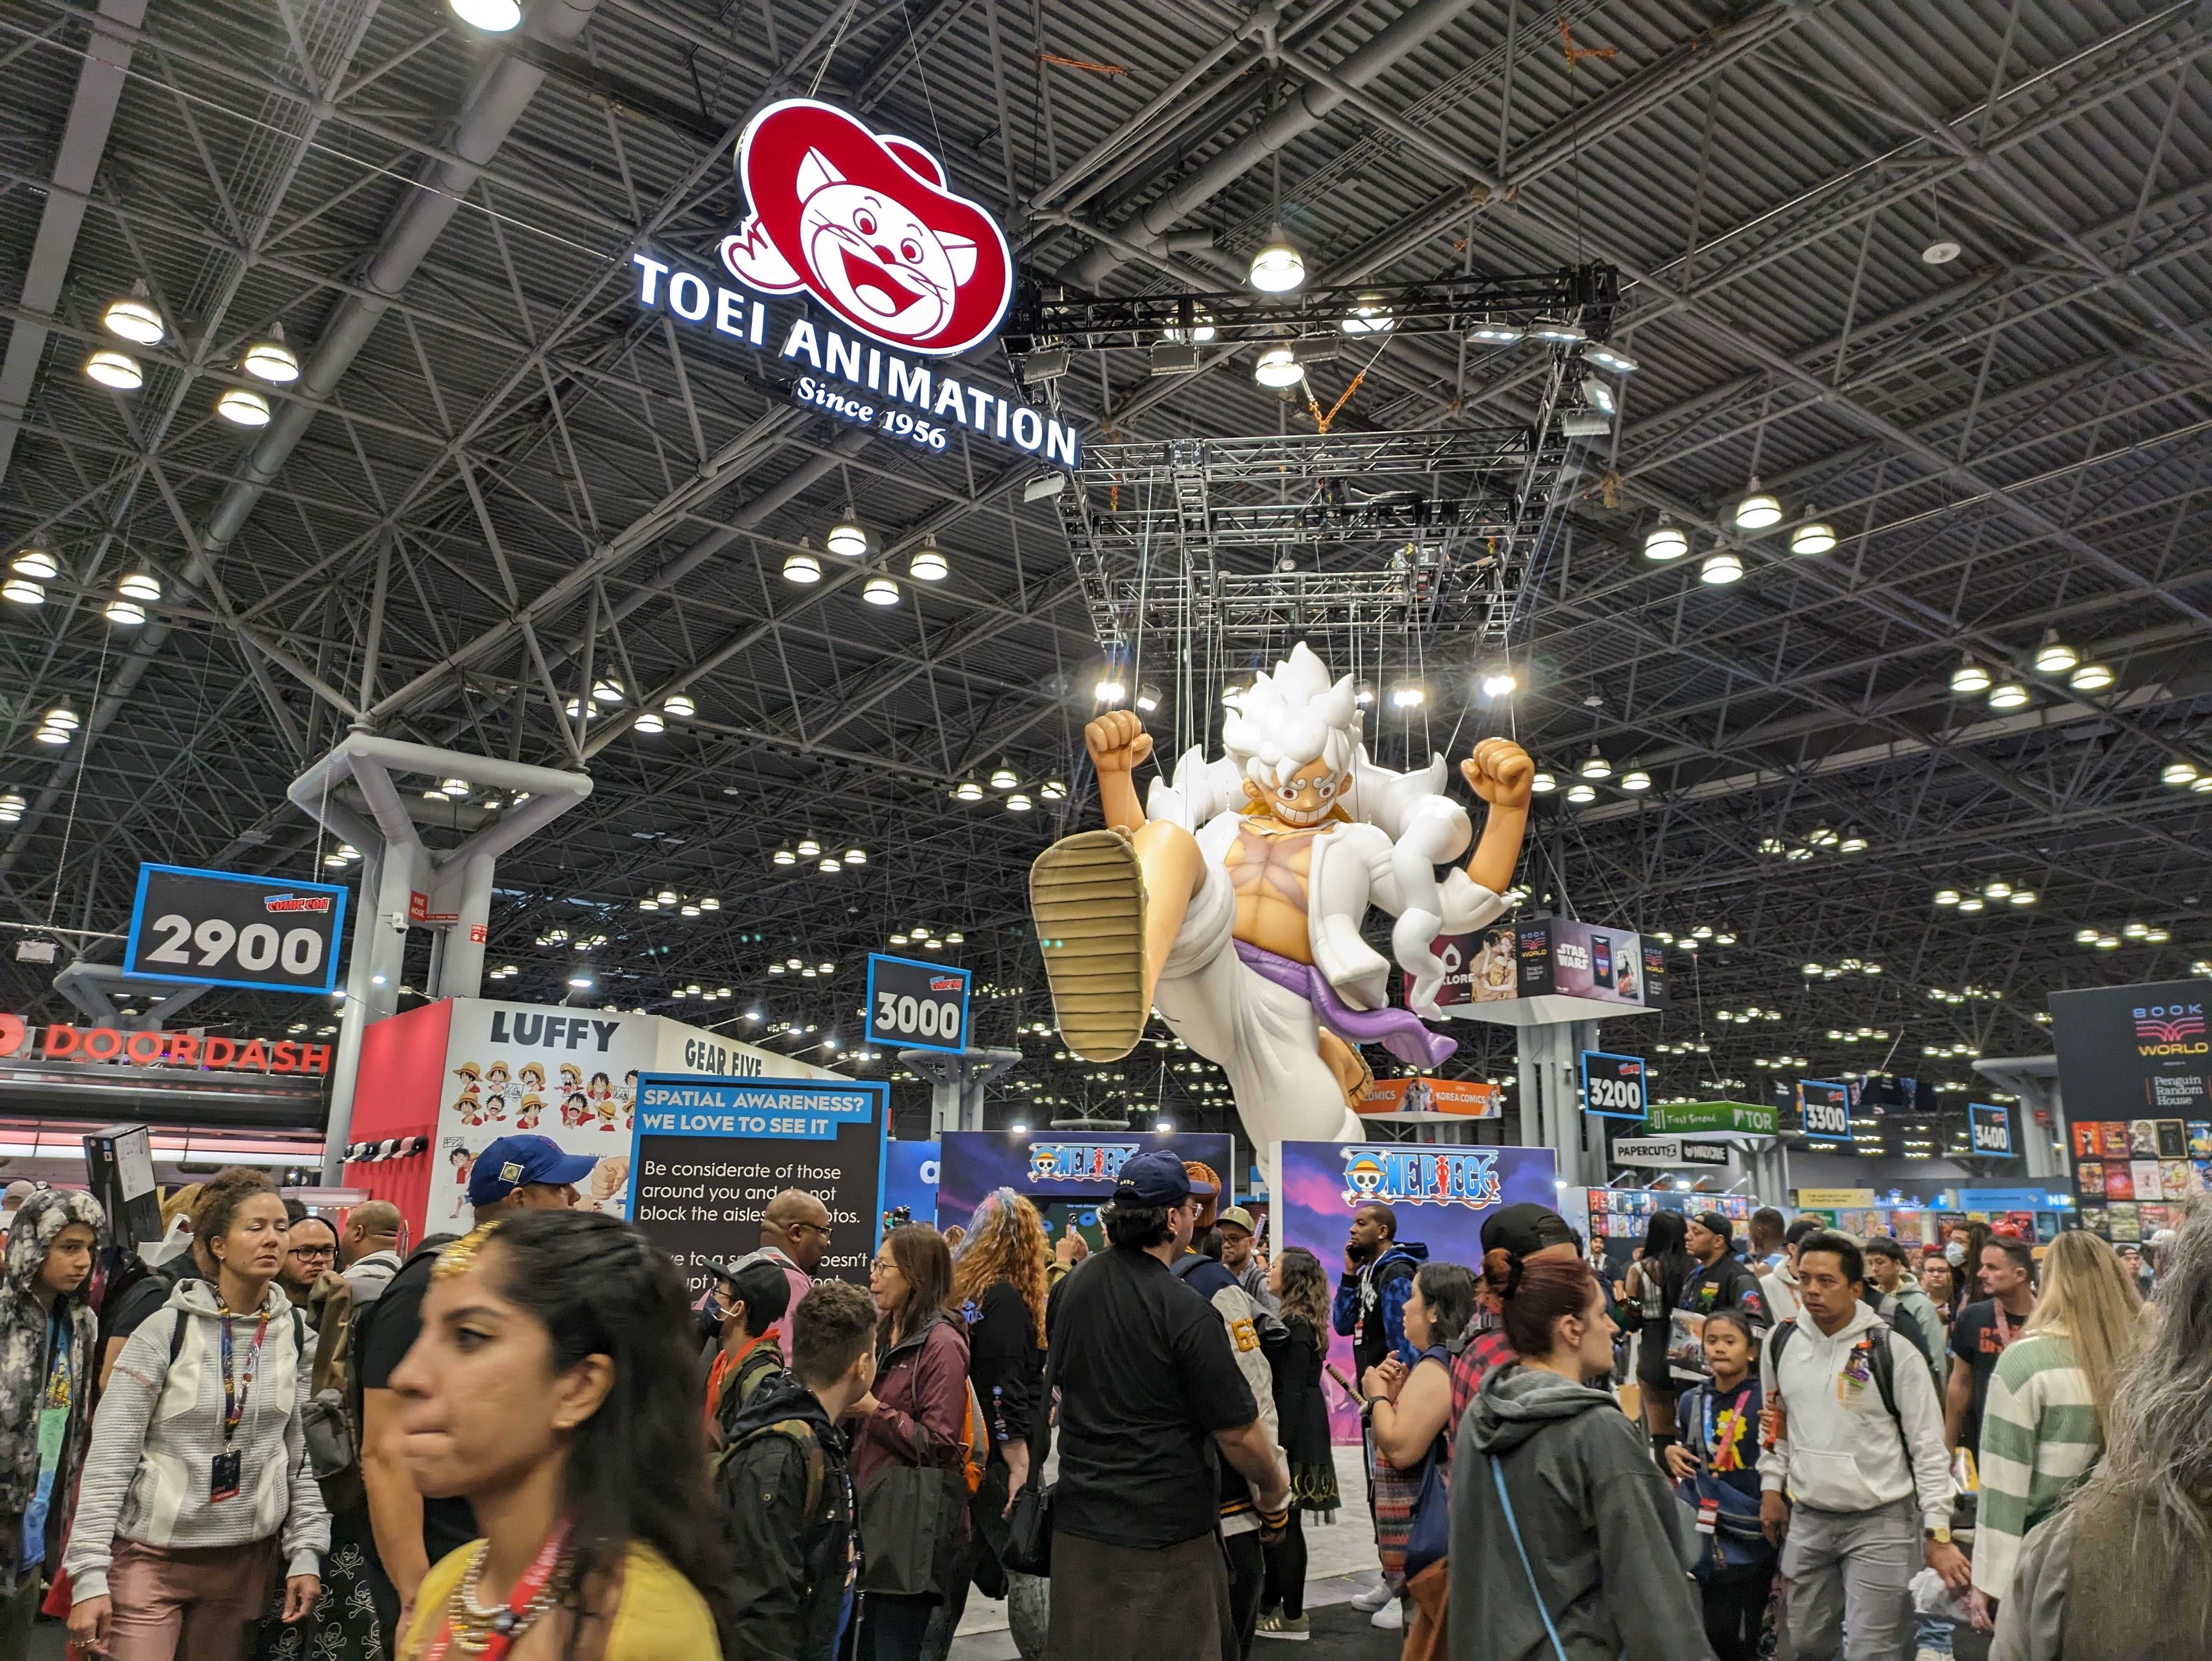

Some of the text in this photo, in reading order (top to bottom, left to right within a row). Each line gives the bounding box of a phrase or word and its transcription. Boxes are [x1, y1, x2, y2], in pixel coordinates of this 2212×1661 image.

[633, 254, 1077, 467] TOEI ANIMATION
[797, 376, 947, 450] Since 1956
[268, 899, 304, 911] COMIC
[305, 898, 328, 910] CON
[414, 896, 424, 906] FIRE
[411, 906, 425, 917] HOSE
[145, 914, 323, 975] 2900
[1521, 949, 1547, 957] WORLD
[1557, 943, 1589, 957] STAR
[1557, 954, 1589, 970] WARS
[875, 992, 960, 1039] 3000
[2133, 1003, 2203, 1018] BOOK
[490, 1010, 620, 1052] LUFFY
[45, 1024, 332, 1074] DOORDASH
[685, 1038, 762, 1076] GEAR FIVE
[2138, 1042, 2209, 1056] WORLD
[2154, 1076, 2202, 1086] Penguin
[1436, 1091, 1486, 1104] KOREA COMICS
[1590, 1077, 1641, 1109] 3200
[2156, 1086, 2203, 1096] Random
[643, 1089, 726, 1107] SPATIAL
[732, 1092, 864, 1112] AWARENESS?
[2157, 1096, 2192, 1106] House
[642, 1113, 829, 1134] WE LOVE TO SEE IT
[1745, 1110, 1772, 1130] TOR
[1806, 1104, 1846, 1132] 3300
[1975, 1124, 2008, 1149] 3400
[1618, 1144, 1677, 1157] PAPERCUTZ
[645, 1160, 841, 1179] Be considerate of those
[1345, 1152, 1501, 1198] ONE PIECE
[642, 1184, 704, 1198] around
[709, 1188, 740, 1203] you
[745, 1185, 777, 1200] and
[810, 1186, 836, 1201] not
[1875, 1195, 1925, 1208] Hallmark
[640, 1205, 686, 1221] block
[691, 1206, 718, 1221] the
[723, 1208, 766, 1222] aisles
[820, 1252, 867, 1267] oesn't
